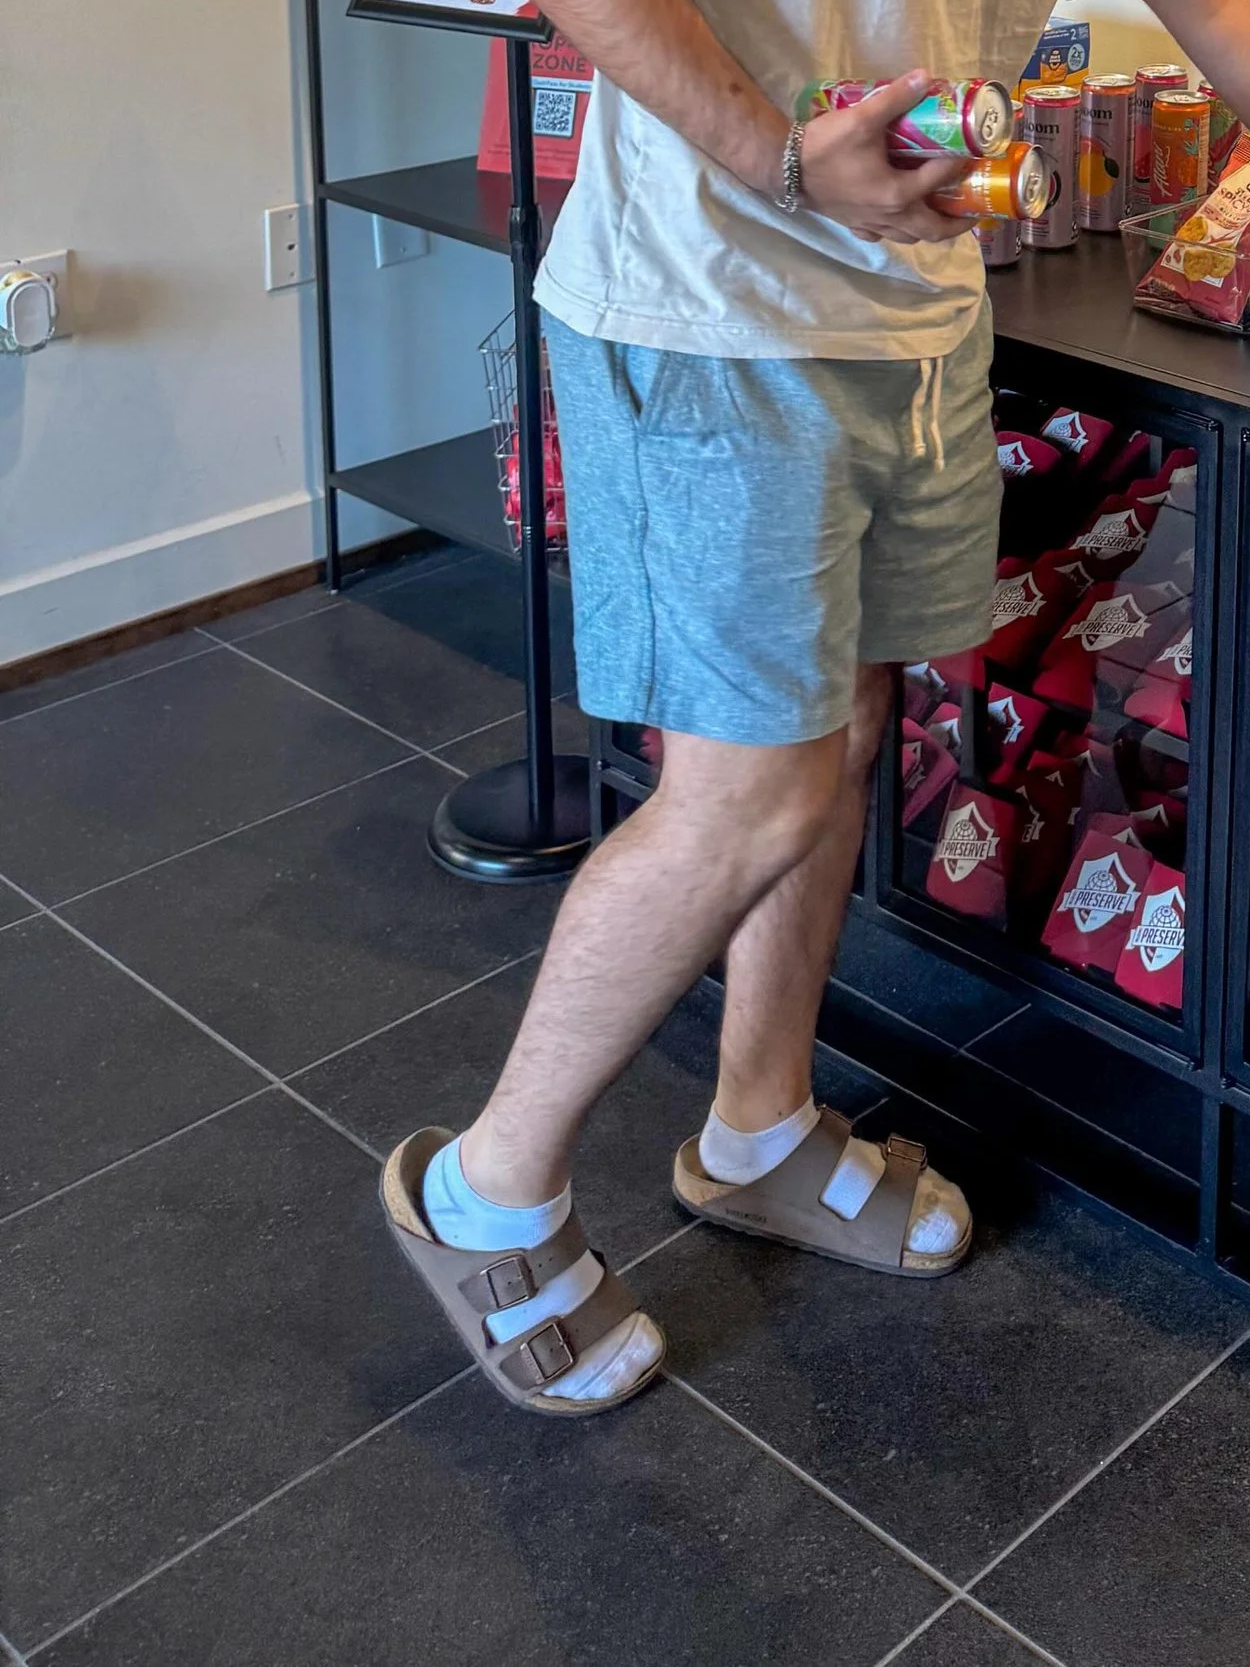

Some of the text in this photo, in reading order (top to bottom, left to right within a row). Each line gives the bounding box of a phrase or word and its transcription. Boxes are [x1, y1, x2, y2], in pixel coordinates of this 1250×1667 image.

[533, 54, 587, 73] ZONE
[1089, 535, 1133, 550] PRESERVE
[993, 601, 1028, 615] RESERVE
[1086, 622, 1137, 636] PRESERVE
[945, 841, 986, 858] PRESERVE
[1075, 891, 1126, 911] PRESERVE
[1142, 928, 1184, 946] PRESERV
